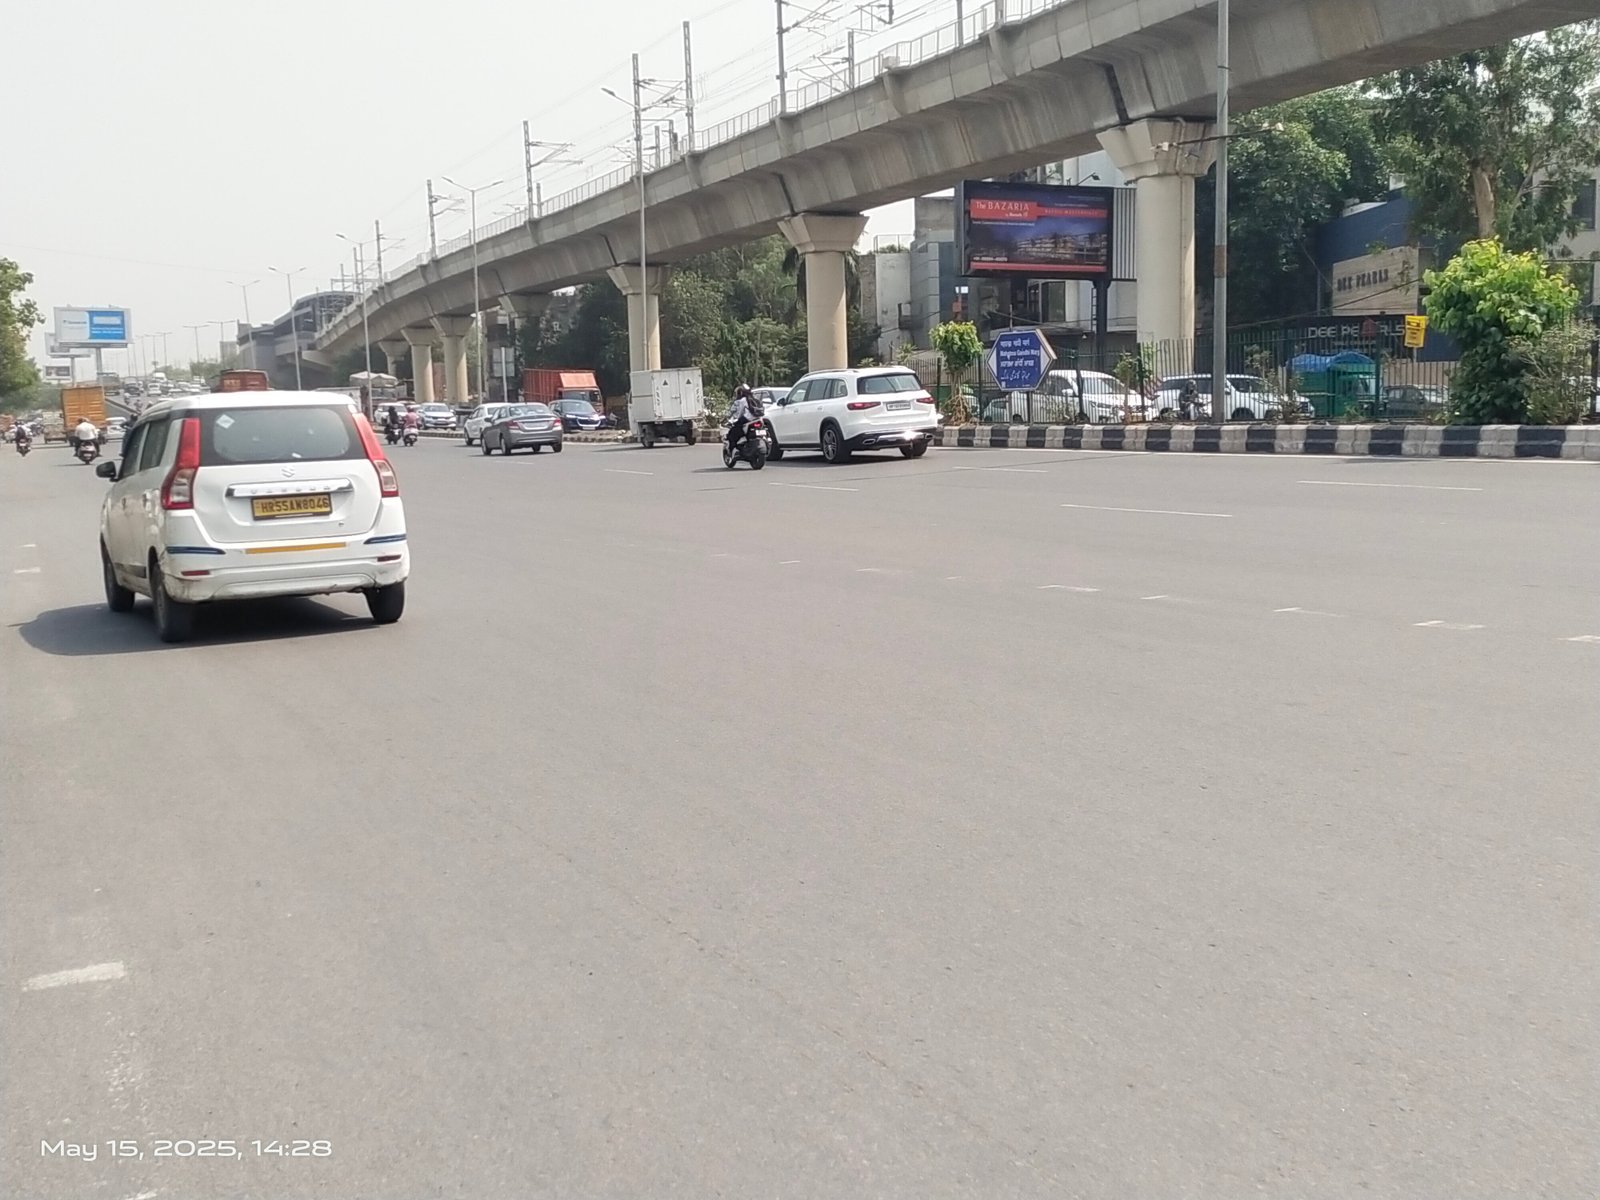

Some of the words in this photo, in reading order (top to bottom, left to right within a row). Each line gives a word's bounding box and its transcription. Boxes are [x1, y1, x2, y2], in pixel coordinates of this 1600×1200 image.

[976, 201, 986, 209] The
[988, 201, 1029, 211] BAZARIA
[1308, 326, 1337, 338] DEE
